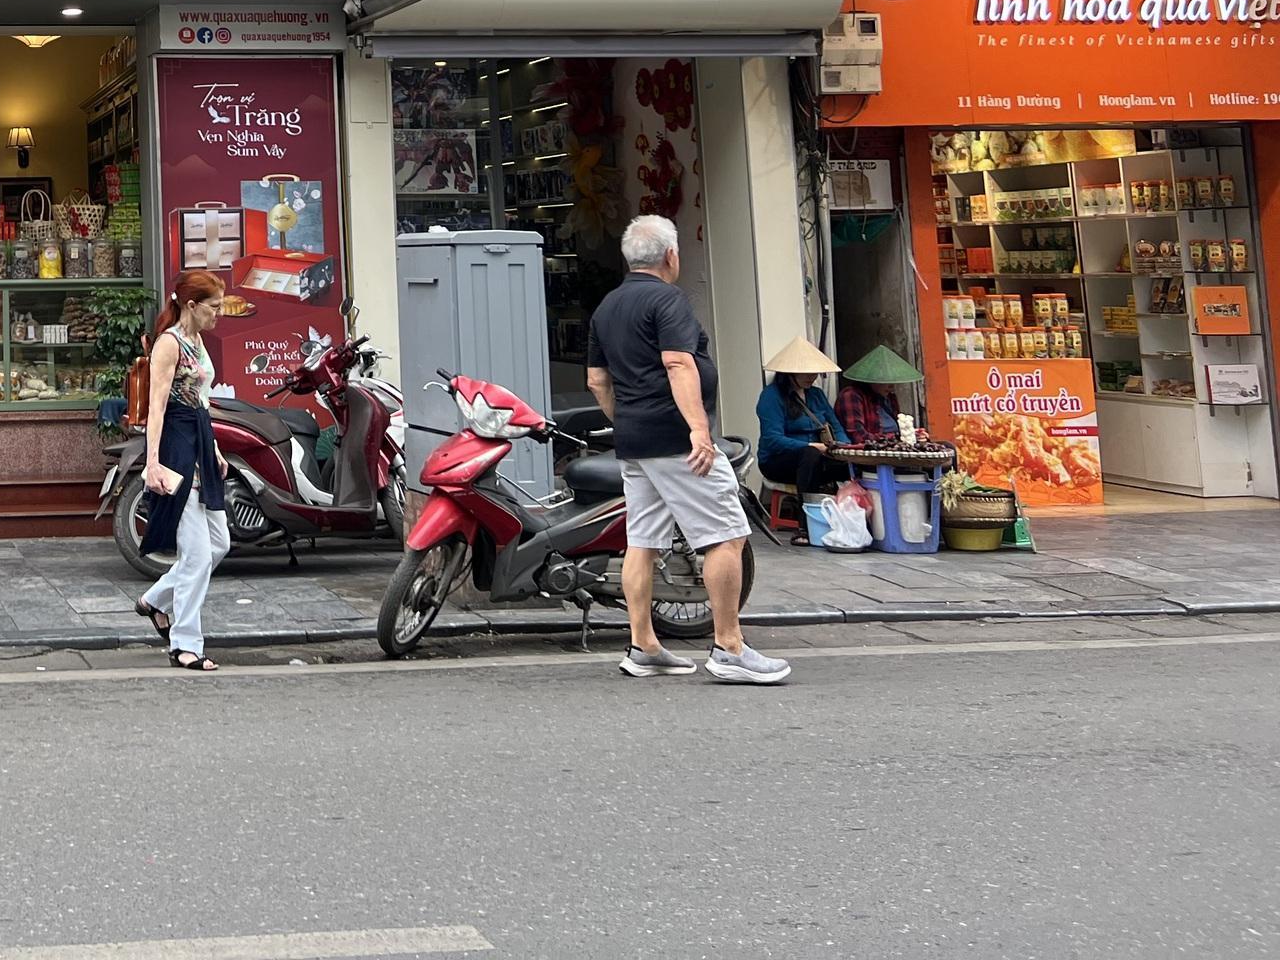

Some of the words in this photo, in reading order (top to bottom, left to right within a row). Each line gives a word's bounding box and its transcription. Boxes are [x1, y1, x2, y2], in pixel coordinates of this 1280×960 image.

[241, 31, 331, 43] quaxuaquehuong1954
[977, 32, 1009, 47] The
[1017, 32, 1075, 48] finest
[1086, 32, 1107, 48] of
[1115, 33, 1221, 47] Vietnamese
[1230, 33, 1275, 49] gifts
[958, 95, 972, 108] 11
[977, 95, 1011, 109] Hàng
[1016, 94, 1061, 110] Đường
[1209, 93, 1260, 107] Hotline:
[226, 104, 303, 136] Trăng
[197, 129, 223, 144] Vẹn
[226, 129, 265, 147] Nghĩa
[226, 144, 259, 157] Sum
[988, 365, 1001, 389] Ô
[1007, 368, 1042, 389] mai
[952, 394, 992, 414] mứt
[996, 386, 1017, 414] cổ
[1020, 387, 1082, 417] truyền
